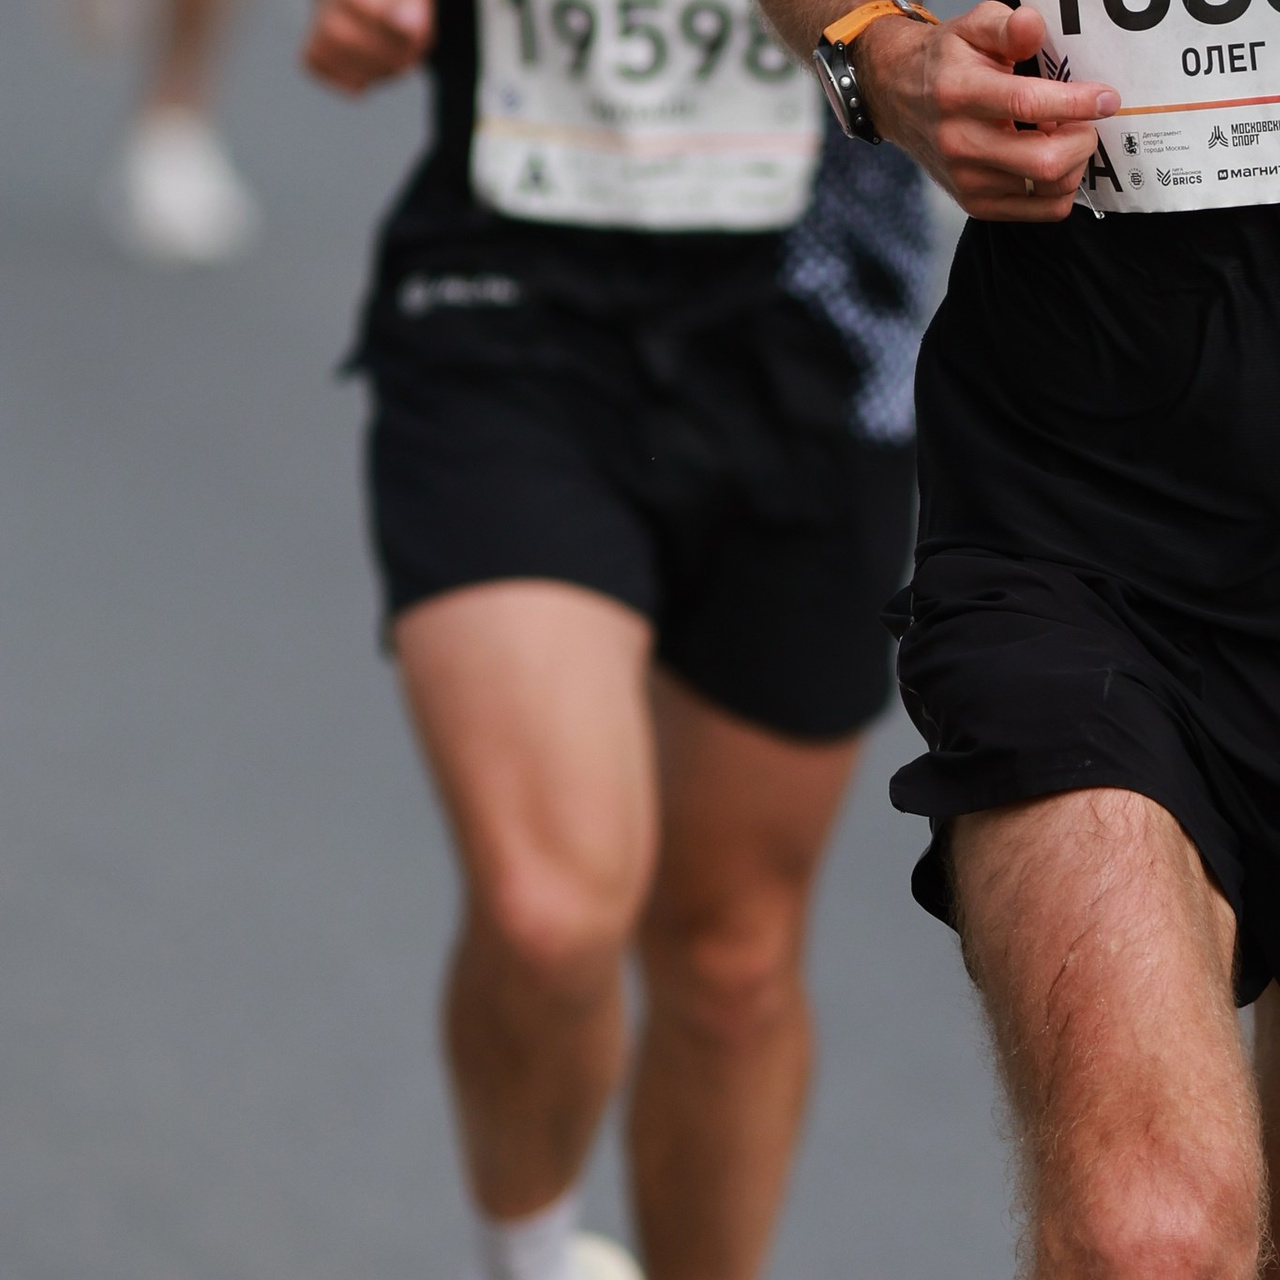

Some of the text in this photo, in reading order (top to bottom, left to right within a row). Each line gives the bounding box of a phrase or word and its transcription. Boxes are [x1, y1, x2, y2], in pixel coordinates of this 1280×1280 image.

[1181, 41, 1266, 77] ОЛЕГ
[1232, 133, 1260, 147] СПОРТ
[1172, 175, 1202, 186] BRICS
